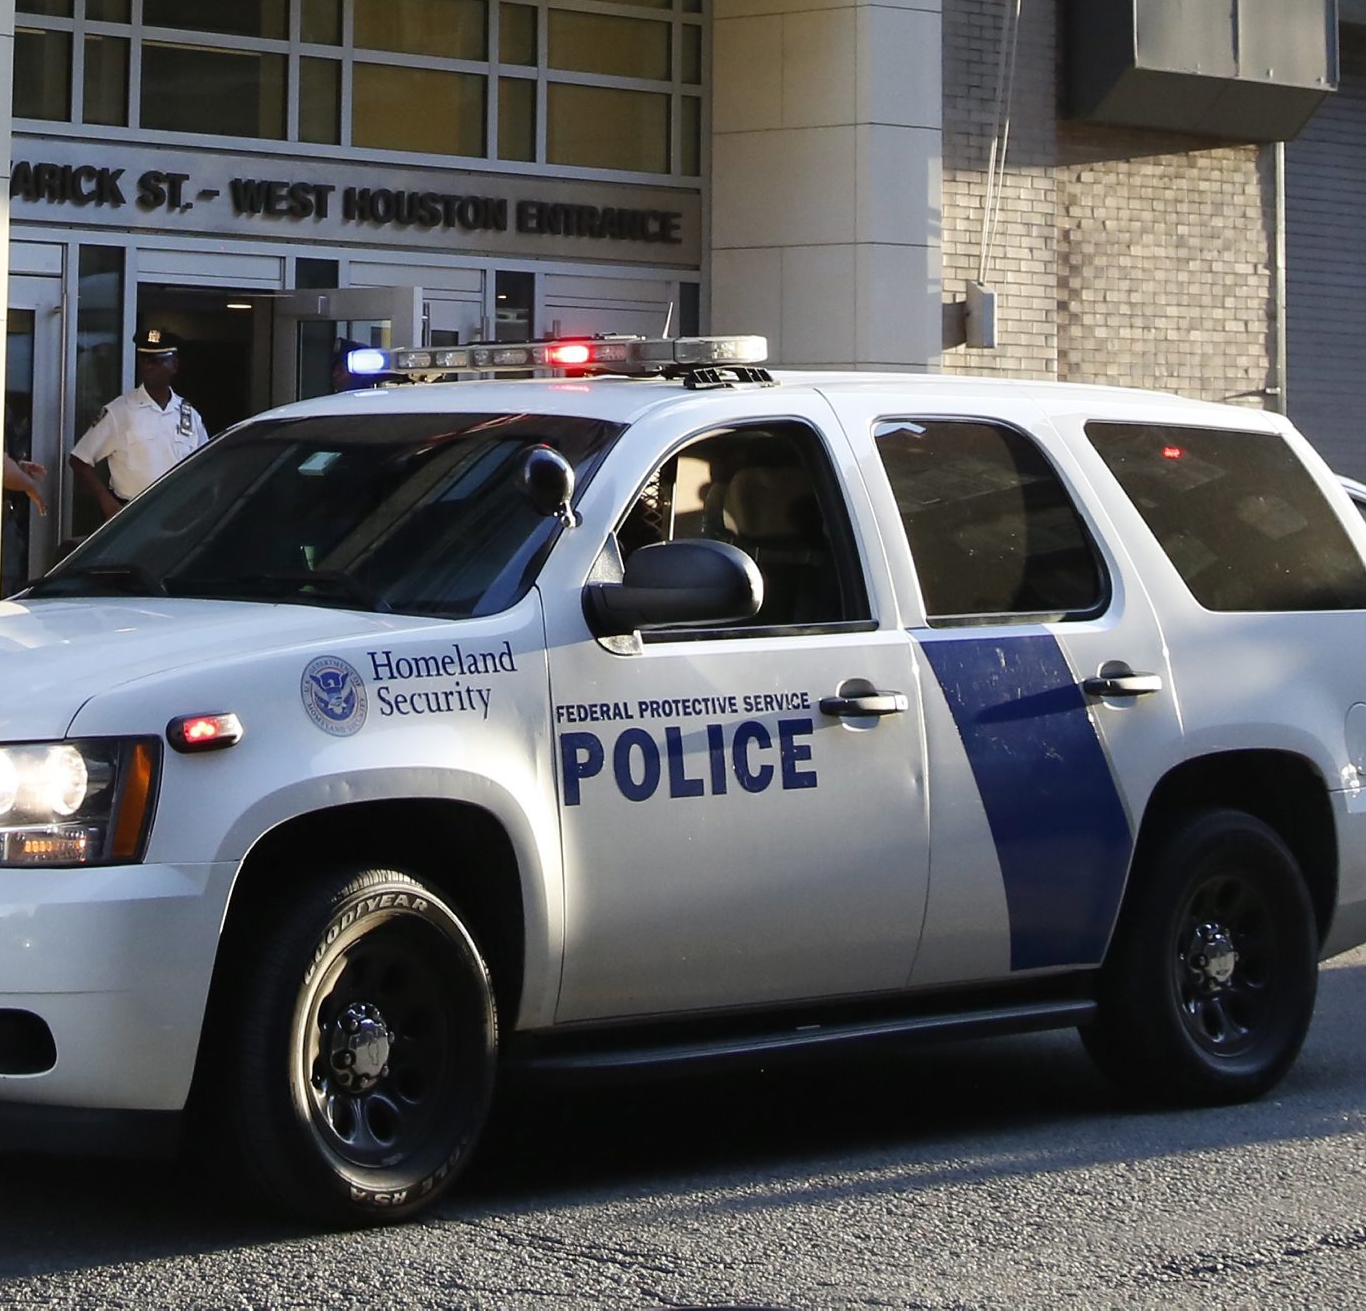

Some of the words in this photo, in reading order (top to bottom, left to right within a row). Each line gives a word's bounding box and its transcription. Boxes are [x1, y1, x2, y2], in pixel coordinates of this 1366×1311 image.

[10, 160, 127, 206] ARICK
[232, 178, 335, 220] WEST
[343, 186, 508, 233] HOUSTON
[516, 199, 683, 245] ENTRANCE
[367, 641, 518, 680] Homeland
[377, 681, 492, 720] Security
[556, 701, 634, 724] FEDERAL
[638, 696, 738, 718] PROTECTIVE
[743, 692, 811, 713] SERVICE
[559, 718, 818, 806] POLICE
[304, 894, 428, 985] GOODYEAR
